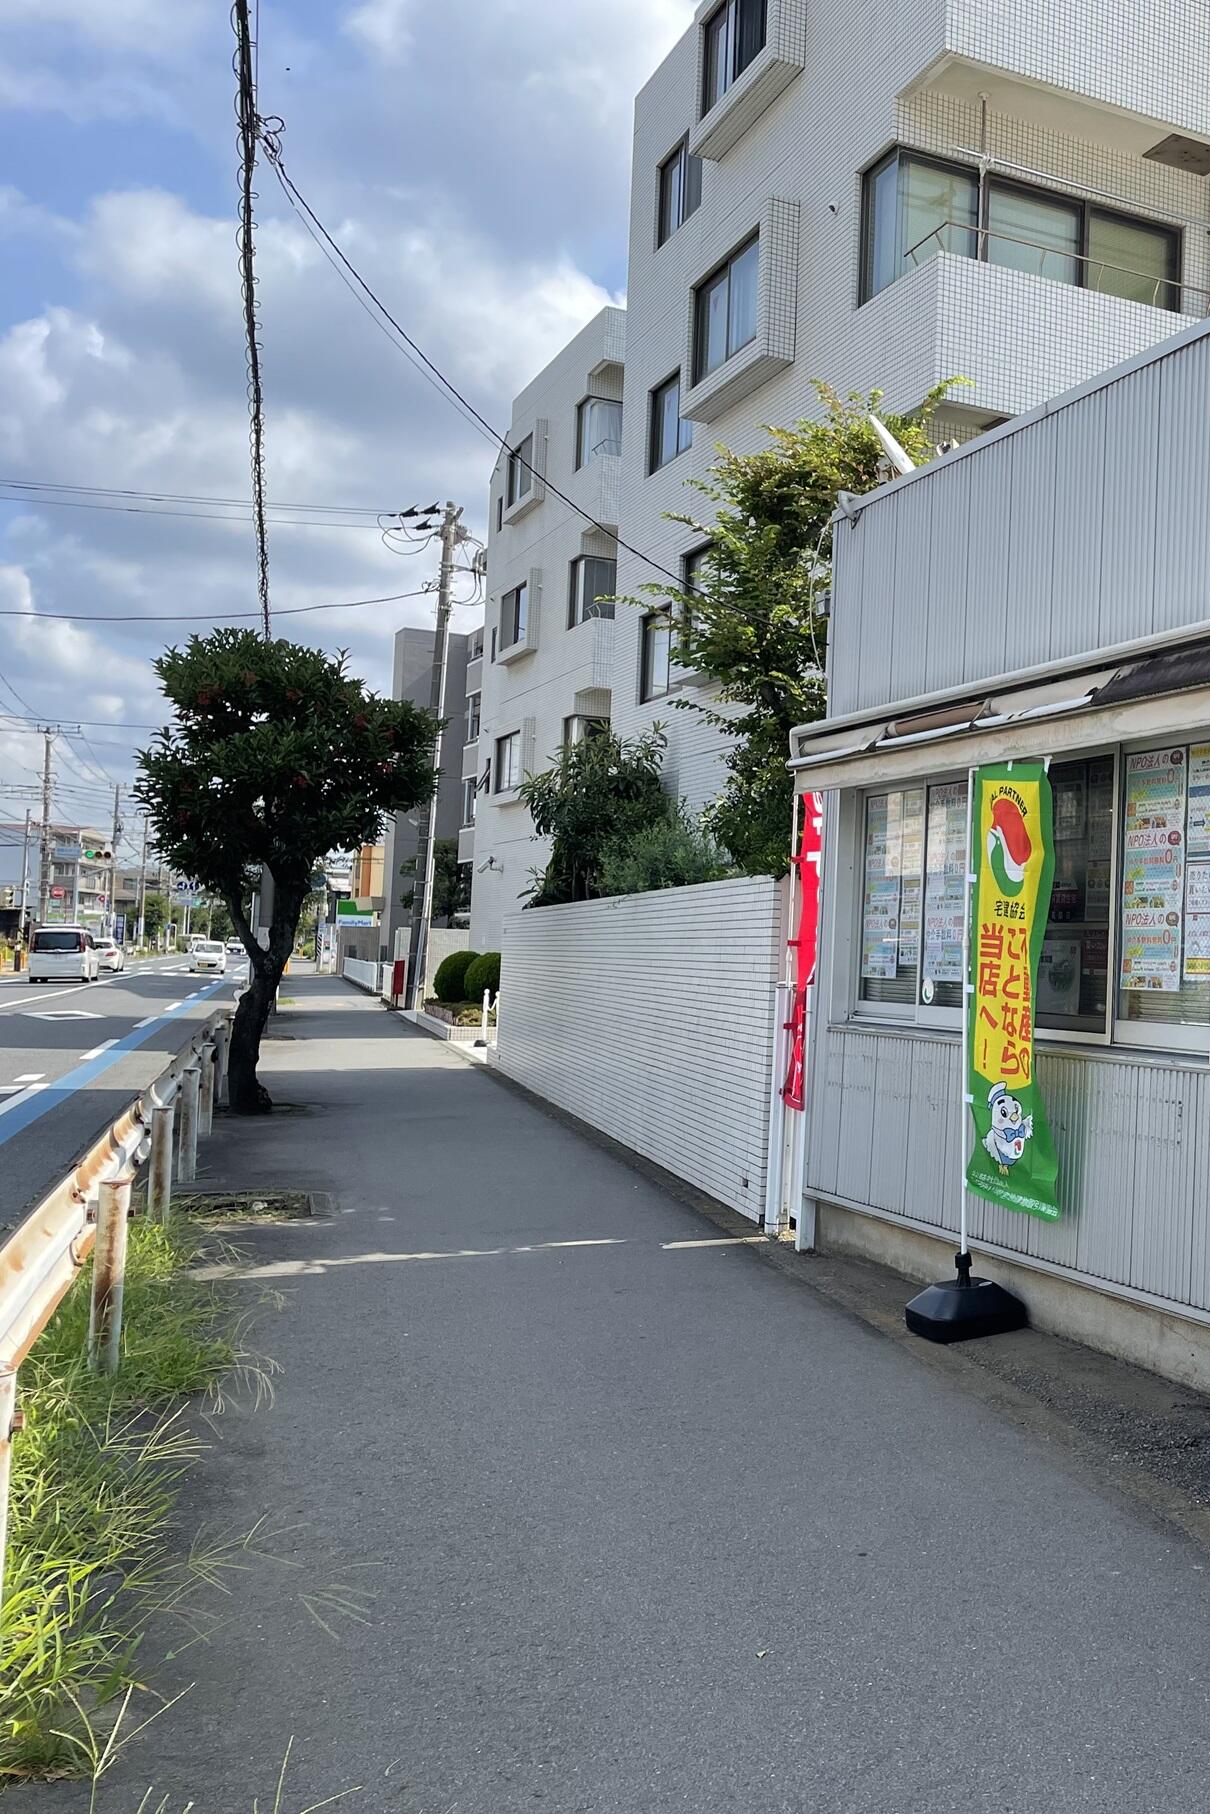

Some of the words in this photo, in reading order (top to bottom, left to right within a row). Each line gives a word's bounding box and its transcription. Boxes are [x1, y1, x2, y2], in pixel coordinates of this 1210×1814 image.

[999, 785, 1028, 818] PARTNER
[1128, 833, 1167, 847] NPO法人の
[994, 900, 1026, 920] 宅建協会
[1125, 913, 1164, 926] NPO法人の
[979, 922, 1004, 1070] 当店へ!
[1000, 927, 1021, 1075] ことなら
